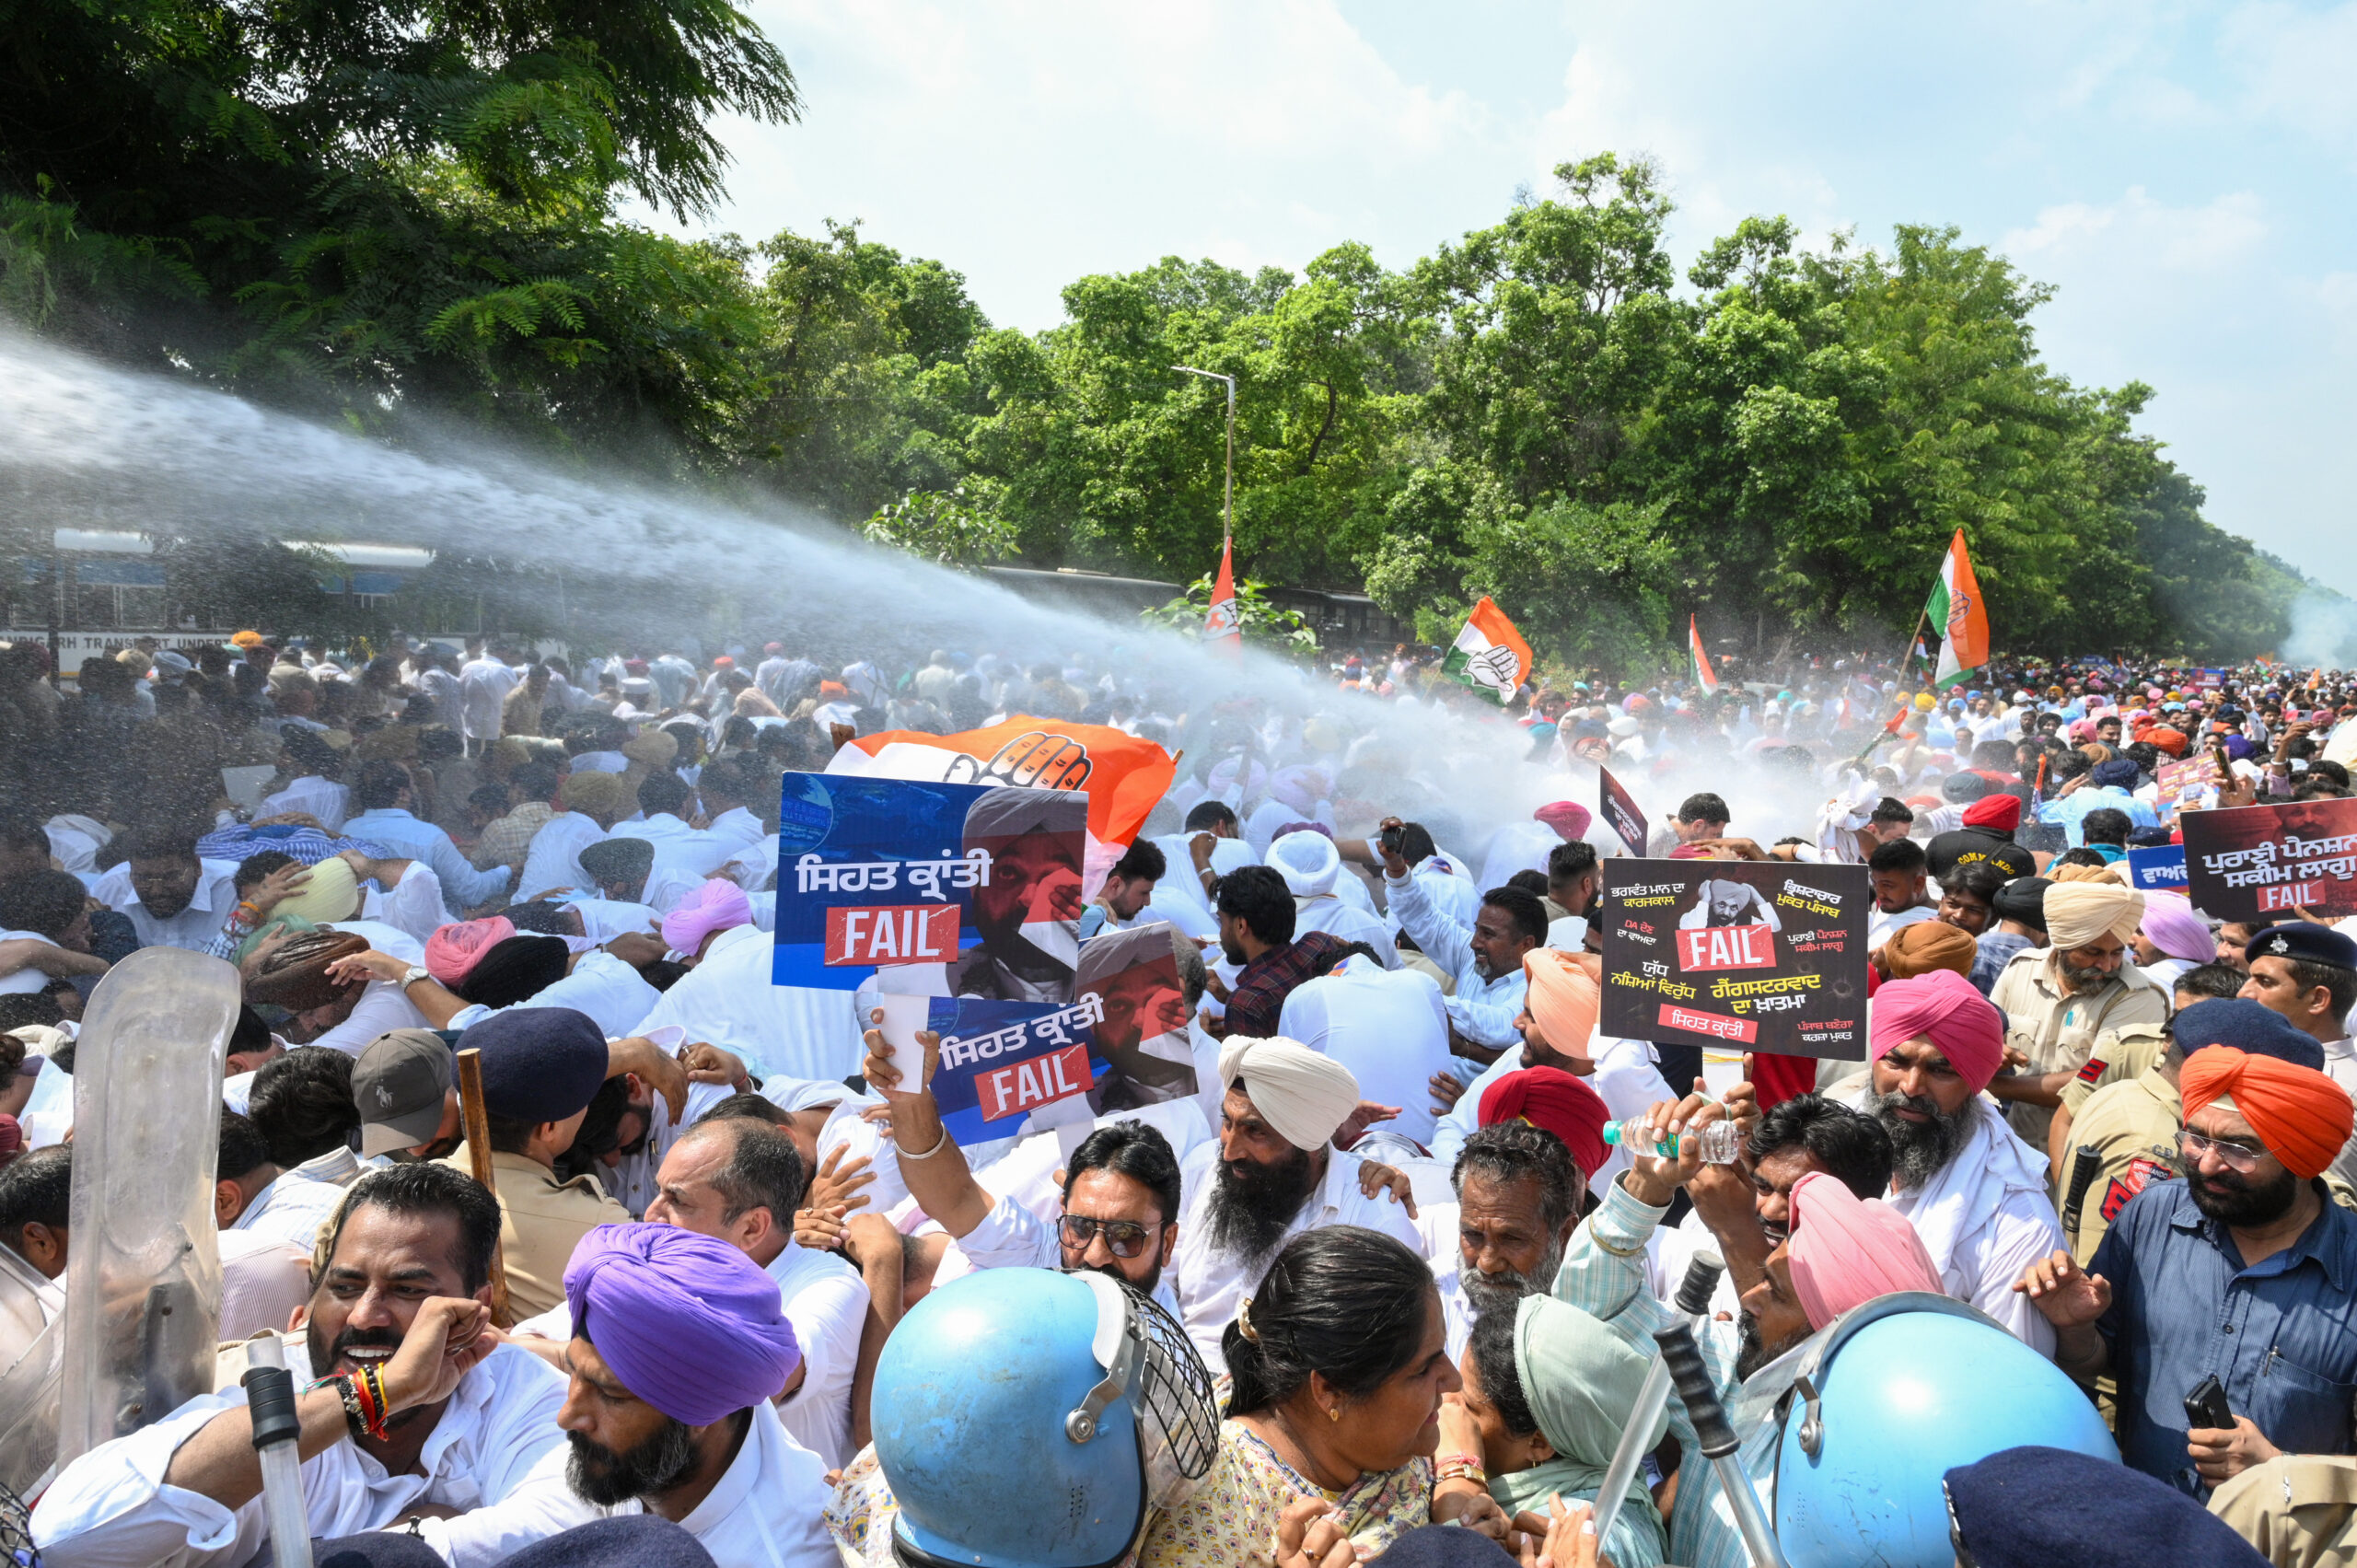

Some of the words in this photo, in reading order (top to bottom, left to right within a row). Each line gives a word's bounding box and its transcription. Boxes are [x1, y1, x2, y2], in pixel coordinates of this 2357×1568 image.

[1957, 852, 2015, 875] COMMNDO
[2202, 842, 2277, 874] ਪੁਰਾਣੀ
[795, 854, 900, 893] ਸਿਹਤ
[905, 848, 994, 902] ਕ੍ਰਾਂਤੀ
[2223, 863, 2293, 888] ਸਕੀਮ
[2295, 855, 2357, 880] ਲਾਗੂ
[1610, 883, 1648, 897] ਭਗਵੰਤ
[1649, 884, 1670, 894] ਮਾਨ
[1672, 883, 1686, 893] ਦਾ
[1623, 896, 1675, 908] ਕਾਰਜਕਾਲ
[2266, 883, 2317, 909] FAIL
[1777, 893, 1805, 909] ਮੁਕਤ
[1806, 900, 1840, 919] ਪੰਜਾਬ
[844, 910, 942, 959] FAIL
[1617, 928, 1628, 937] ਦਾ
[1624, 919, 1638, 930] DA
[1689, 929, 1764, 967] FAIL
[1787, 931, 1816, 945] ਪੁਰਾਣੀ
[1643, 959, 1669, 977] ਯੁੱਧ
[1611, 971, 1656, 991] ਨਸ਼ਿਆਂ
[1658, 978, 1697, 999] ਵਿਰੁੱਧ
[1710, 974, 1821, 998] ਗੈਂਗਸਟਰਵਾਦ
[1731, 999, 1751, 1014] ਦਾ
[1672, 1009, 1710, 1030] ਸਿਹਤ
[1711, 1019, 1744, 1039] ਕ੍ਰਾਂਤੀ
[1797, 1020, 1823, 1030] ਪੰਜਾਬ
[938, 1023, 1028, 1071] ਸਿਹਤ
[1829, 1031, 1852, 1042] ਮੁਕਤ
[992, 1054, 1078, 1111] FAIL
[2133, 1162, 2168, 1179] COMMANDO
